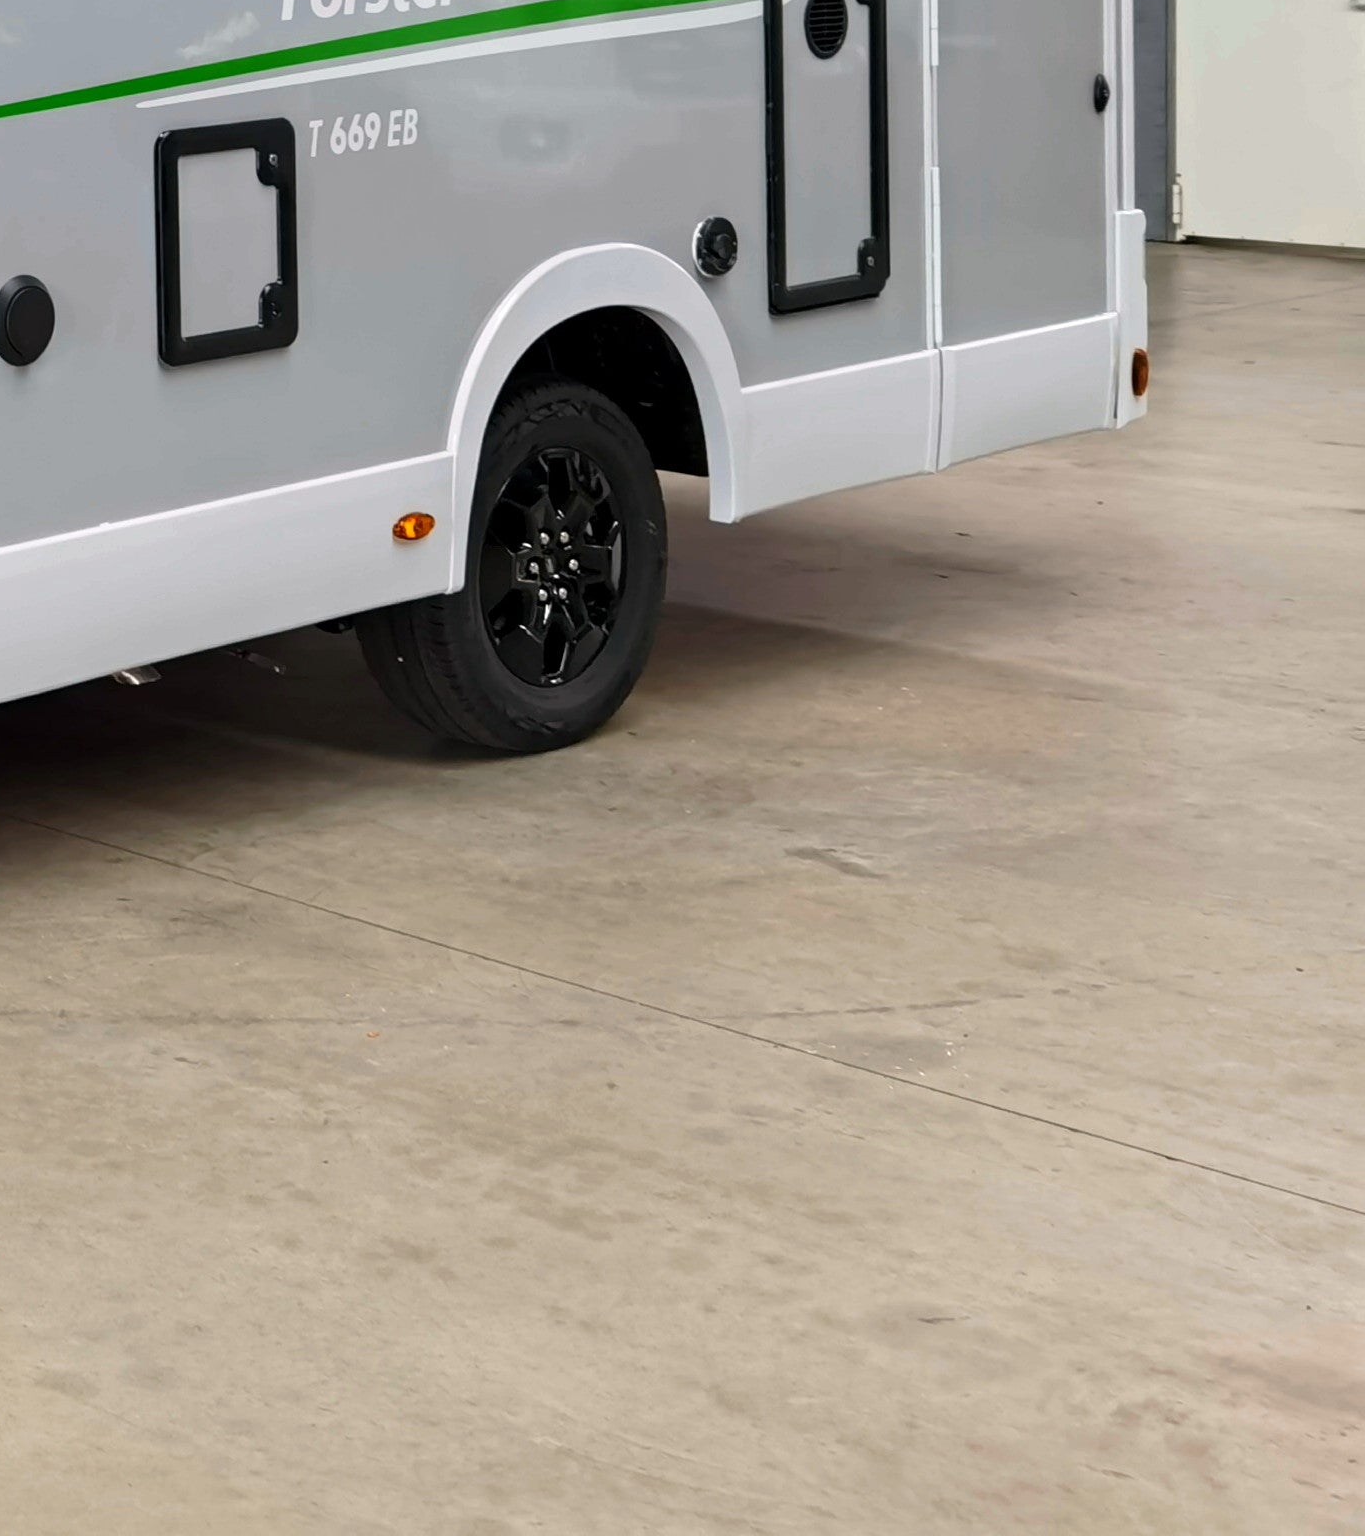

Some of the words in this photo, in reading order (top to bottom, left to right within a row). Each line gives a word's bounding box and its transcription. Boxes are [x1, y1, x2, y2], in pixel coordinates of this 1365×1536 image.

[309, 119, 323, 157] T
[330, 112, 381, 155] 669
[387, 108, 418, 148] EB
